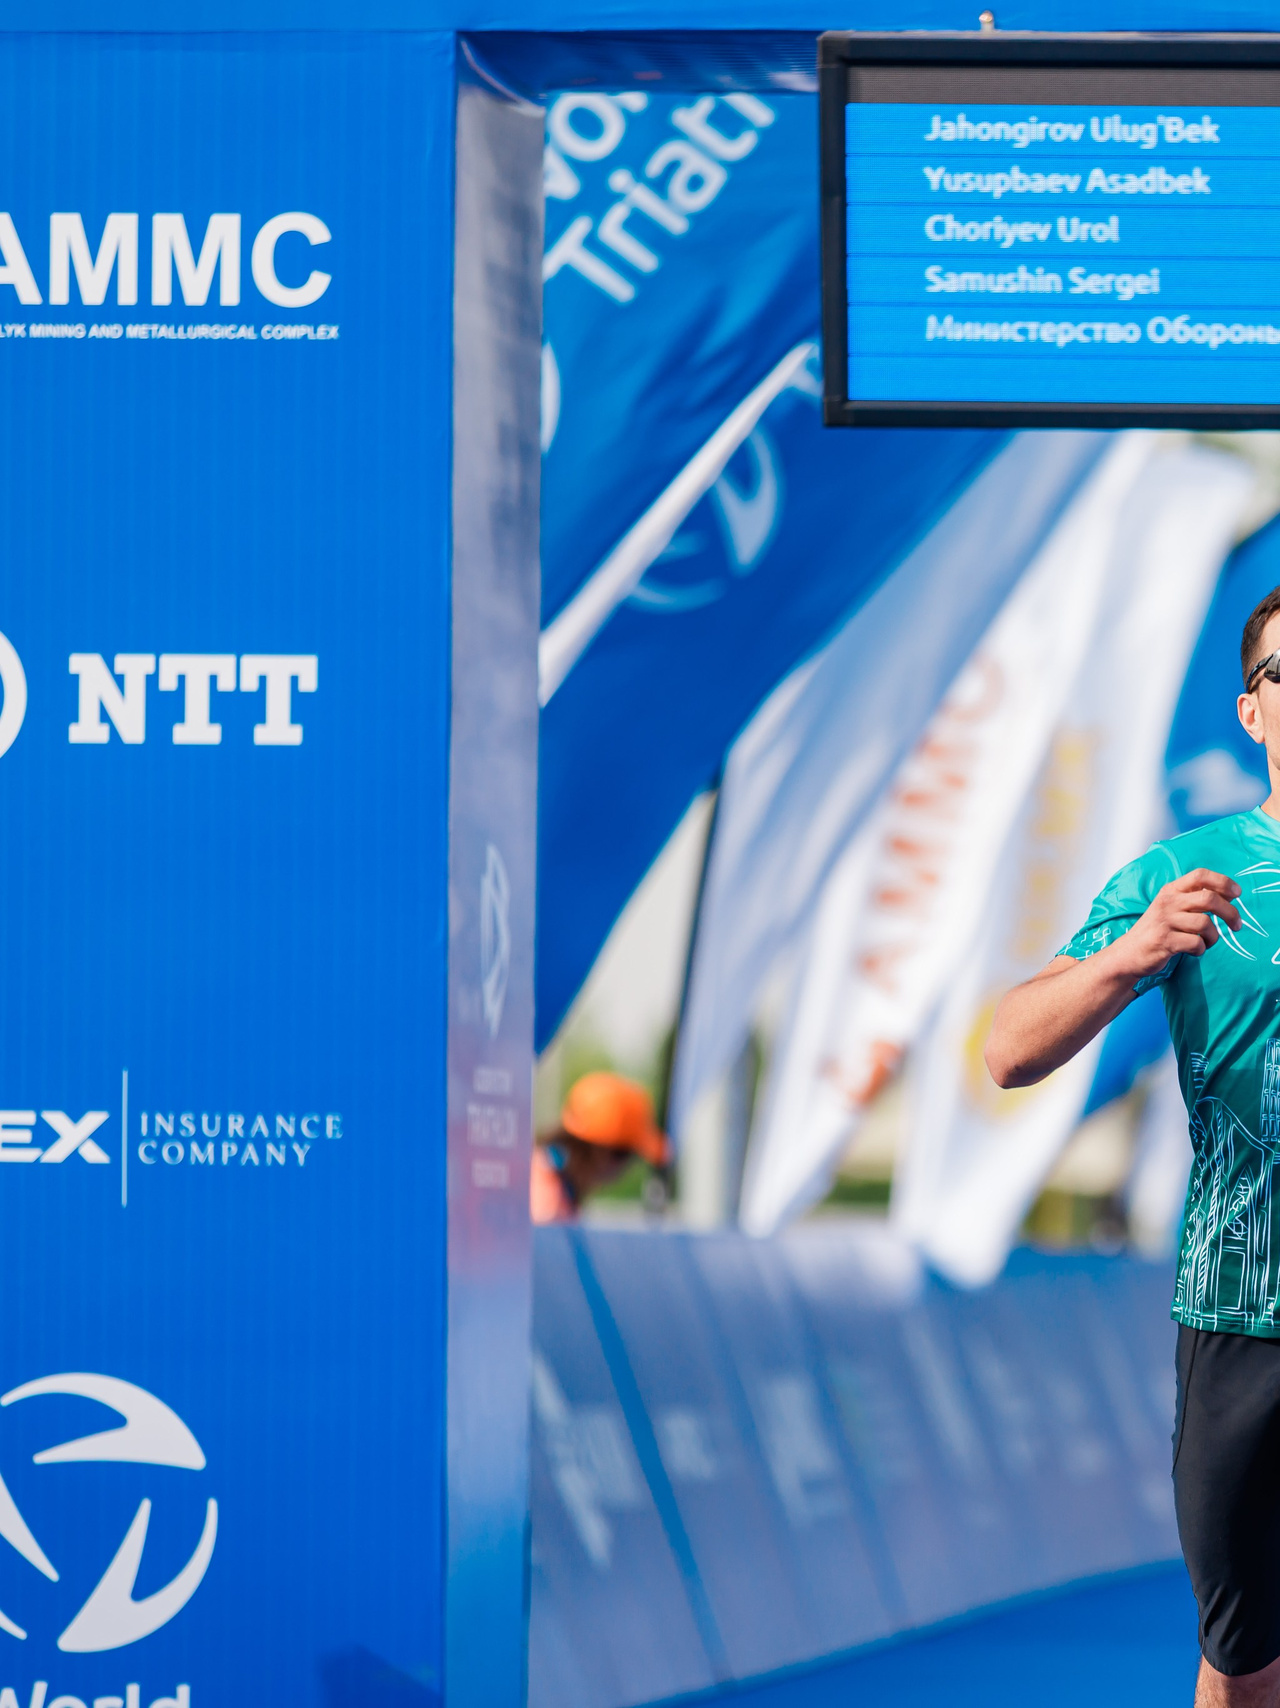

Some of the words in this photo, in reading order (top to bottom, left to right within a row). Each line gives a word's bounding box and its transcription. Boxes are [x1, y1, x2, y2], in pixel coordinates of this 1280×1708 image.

[924, 114, 1085, 148] Jahongirov
[543, 93, 776, 303] Triat
[923, 165, 1082, 198] Yusupbaev
[1086, 167, 1211, 195] Asadbek
[924, 214, 1052, 248] Choriyev
[1057, 215, 1120, 243] Urol
[925, 265, 1063, 294] Samushin
[1068, 266, 1160, 300] Sergei
[29, 323, 87, 339] MINING
[88, 323, 124, 339] AND
[125, 323, 258, 340] METALLURGICAL
[260, 324, 339, 340] COMPLEX
[925, 315, 1142, 347] Министерство
[68, 652, 318, 746] NTT
[140, 1111, 344, 1139] INSURANCE
[137, 1140, 311, 1166] COMPANY
